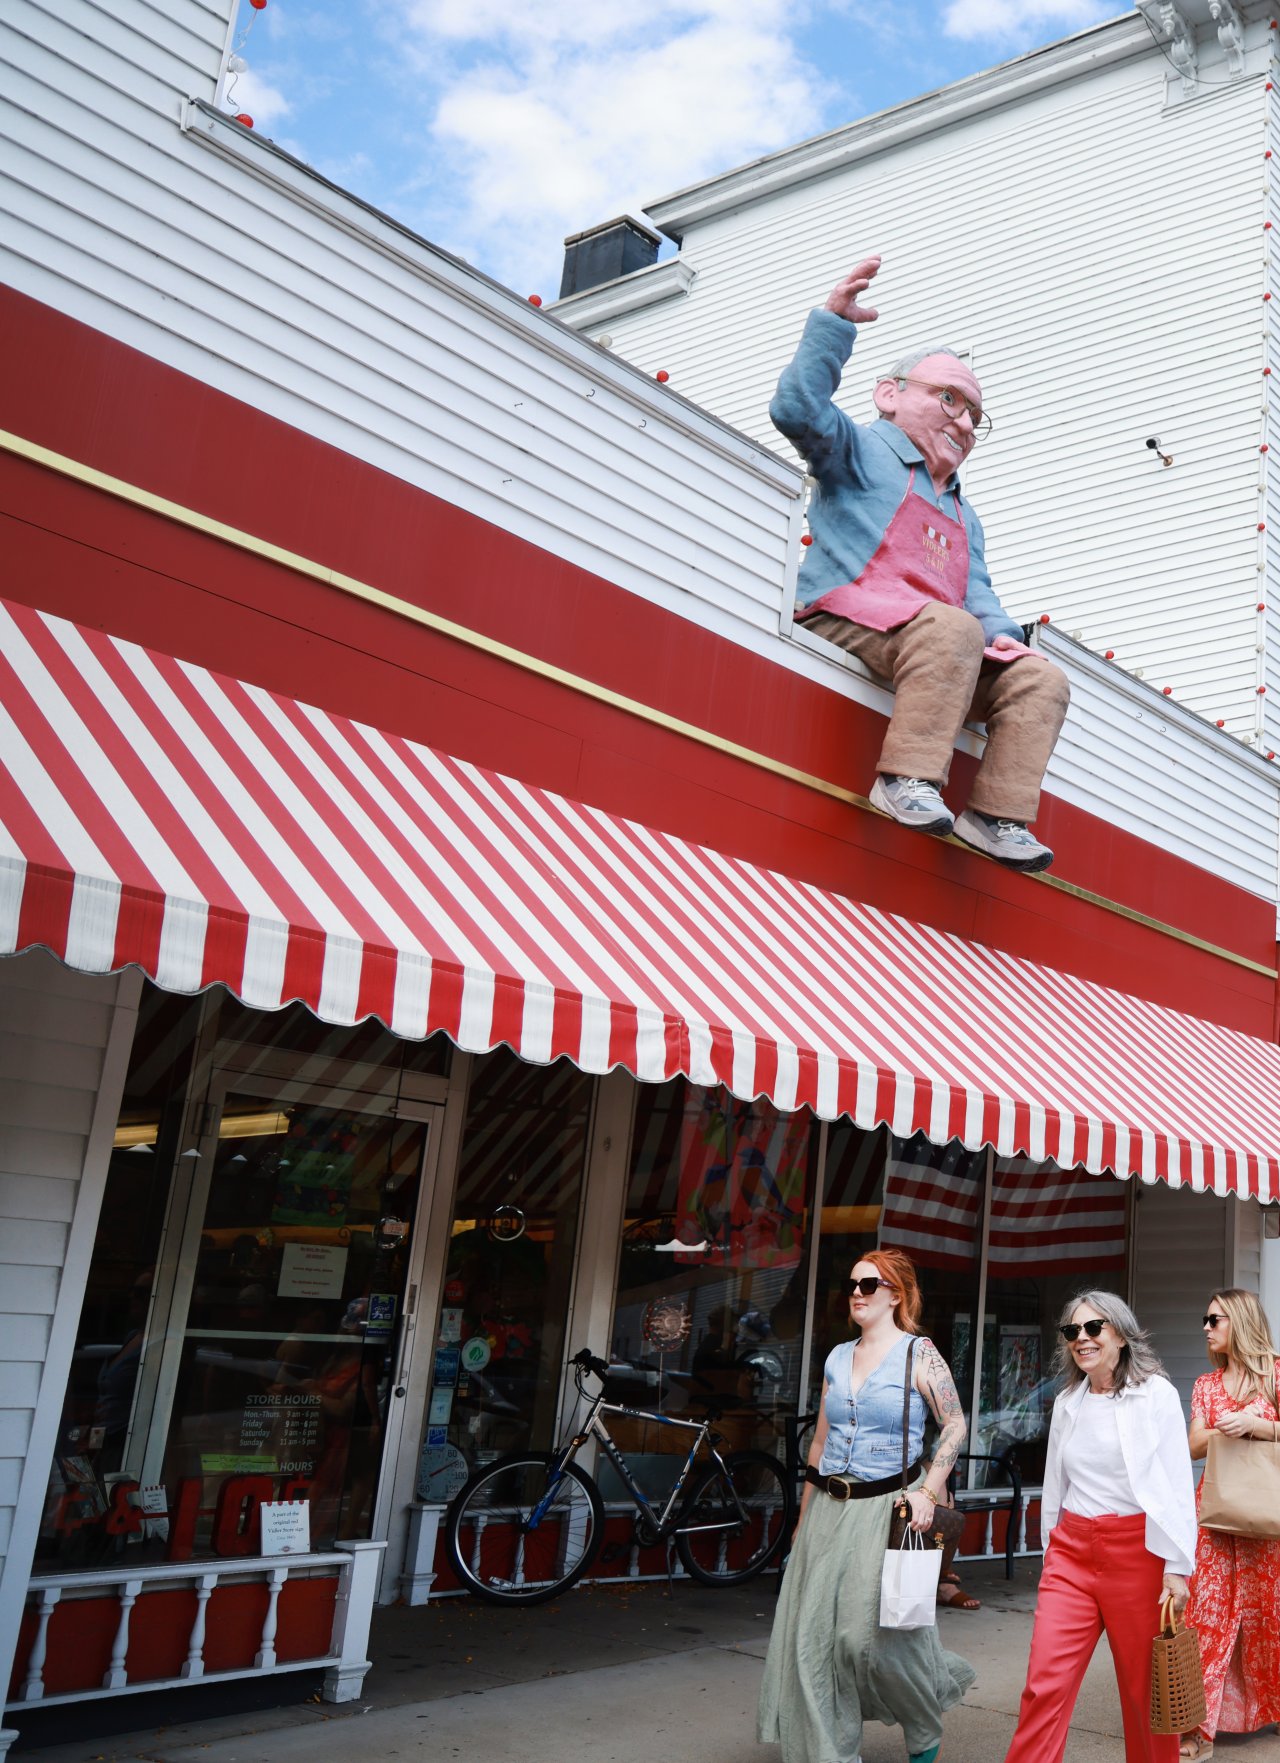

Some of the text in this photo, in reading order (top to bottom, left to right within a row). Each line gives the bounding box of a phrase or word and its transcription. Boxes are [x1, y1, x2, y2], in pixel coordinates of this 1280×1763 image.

[245, 1394, 322, 1405] STORE HOURS
[243, 1410, 281, 1418] Mon.-Thurs.
[309, 1412, 319, 1420] pm
[242, 1420, 264, 1428] Friday
[308, 1421, 319, 1429] pm
[241, 1429, 271, 1438] Saturday
[307, 1431, 317, 1439] pm
[240, 1438, 264, 1448] Sunday
[448, 1449, 457, 1457] 60
[280, 1461, 313, 1472] HOURS
[455, 1471, 467, 1480] 100
